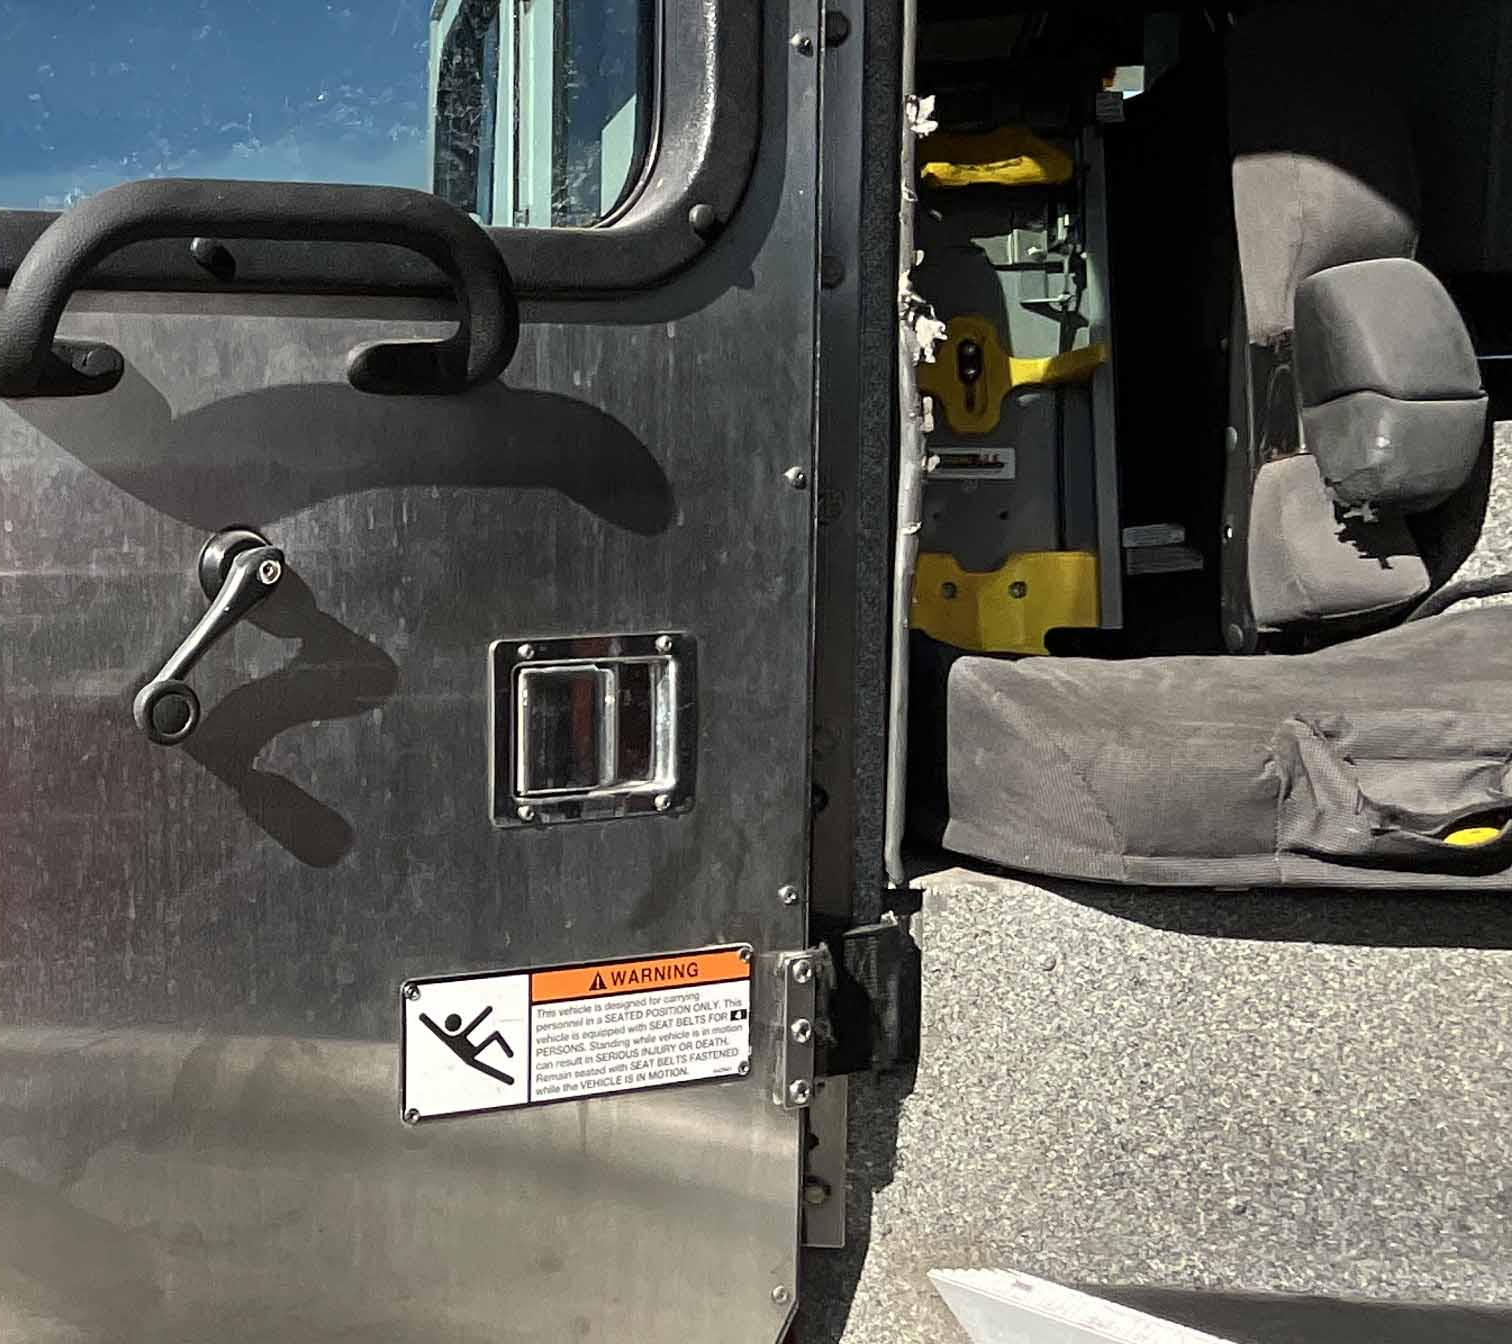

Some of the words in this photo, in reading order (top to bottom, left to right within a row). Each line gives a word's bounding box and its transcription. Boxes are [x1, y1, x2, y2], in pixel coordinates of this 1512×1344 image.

[611, 961, 699, 986] WARNING
[536, 1018, 583, 1033] personnel
[586, 1016, 594, 1026] in
[605, 1011, 643, 1024] SEATED
[645, 1004, 691, 1018] POSITION
[724, 998, 742, 1008] This
[537, 1009, 556, 1018] This
[559, 1005, 592, 1016] vehicle
[594, 1004, 601, 1012] is
[605, 998, 647, 1010] designed
[649, 997, 661, 1005] for
[663, 993, 700, 1003] carrying
[536, 1033, 569, 1044] vehicle
[571, 1032, 579, 1040] is
[582, 1026, 625, 1039] equipped
[628, 1023, 647, 1033] with
[649, 1018, 673, 1030] SEAT
[676, 1015, 706, 1027] BELTS
[709, 1012, 727, 1023] FOR
[590, 1040, 630, 1051] Standing
[633, 1034, 656, 1044] while
[659, 1031, 690, 1041] vehicle
[702, 1028, 710, 1036] in
[712, 1024, 742, 1034] motion
[536, 1061, 553, 1070] can
[555, 1056, 583, 1067] result
[585, 1055, 593, 1064] in
[595, 1048, 639, 1063] SERIOUS
[641, 1044, 676, 1056] INJURY
[679, 1041, 693, 1051] OR
[536, 1071, 572, 1083] Remain
[575, 1066, 606, 1078] seated
[609, 1063, 627, 1073] with
[630, 1059, 655, 1070] SEAT
[657, 1055, 687, 1067] BELTS
[689, 1047, 739, 1061] FASTENED
[536, 1085, 561, 1095] while
[563, 1083, 578, 1092] the
[580, 1075, 622, 1089] VEHICLE
[625, 1074, 633, 1083] IS
[636, 1072, 645, 1081] IN
